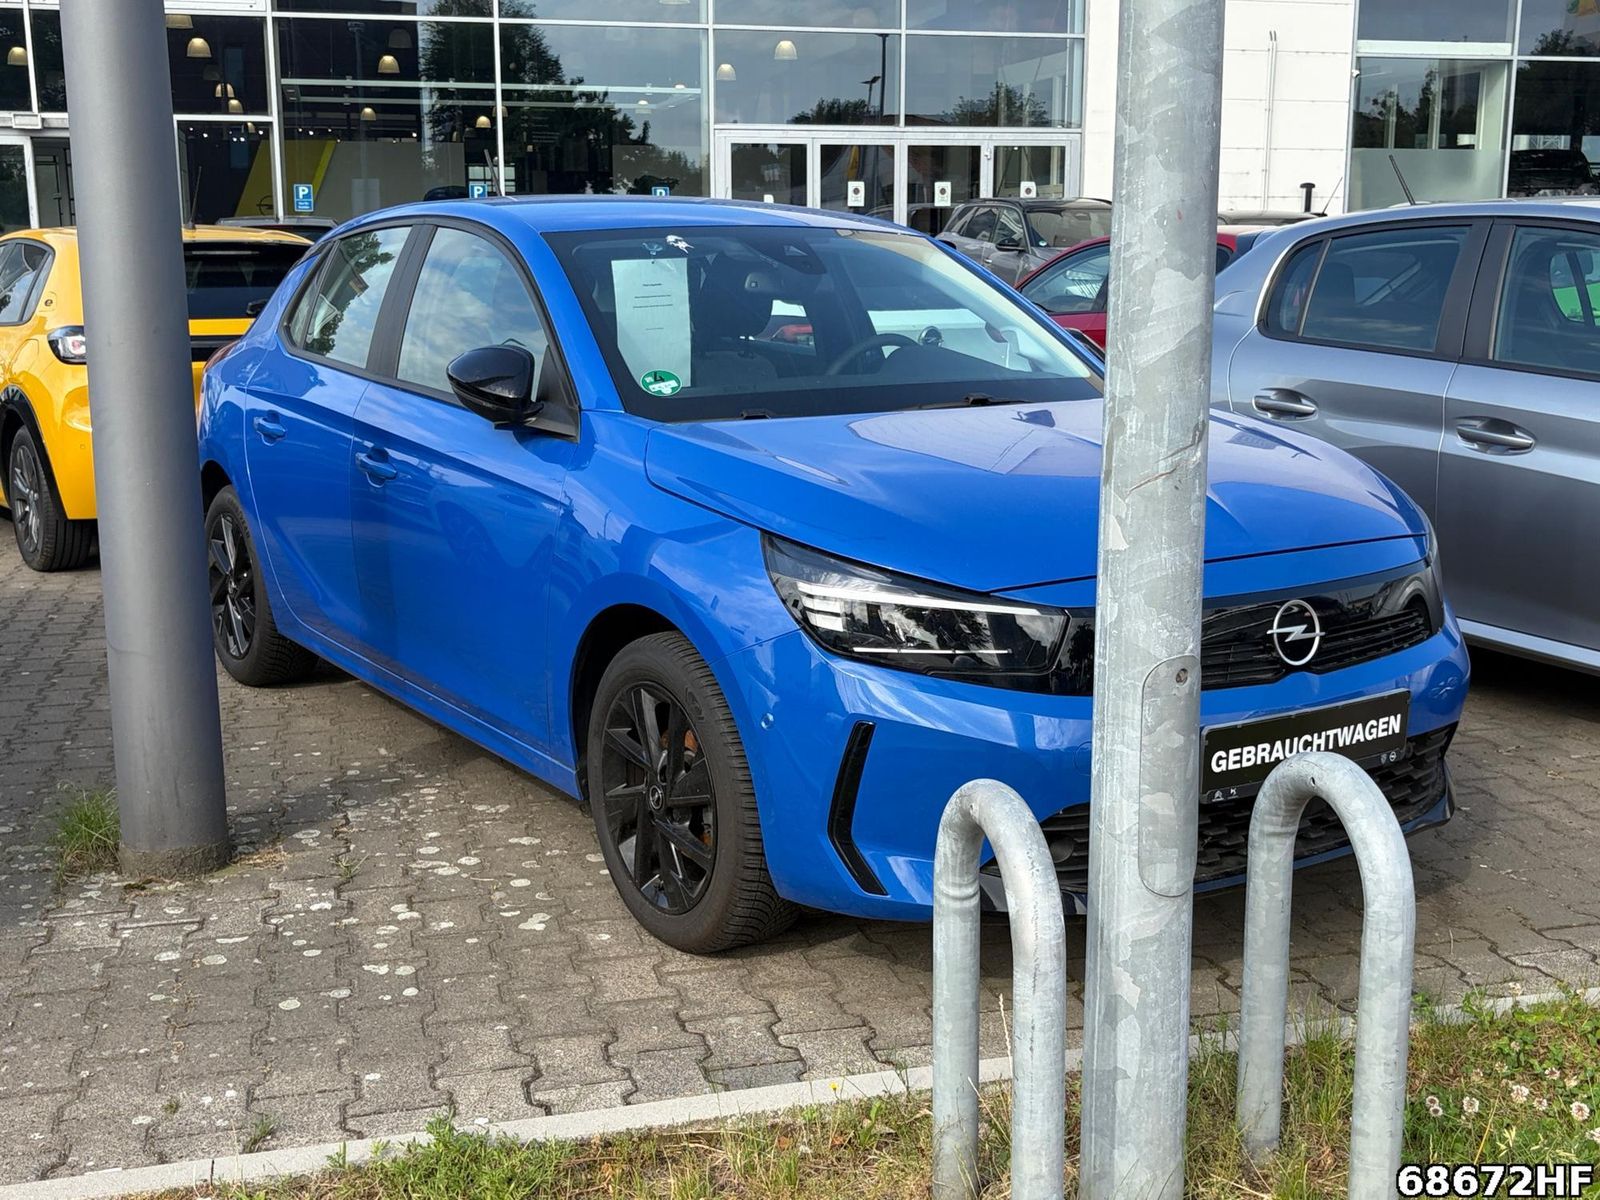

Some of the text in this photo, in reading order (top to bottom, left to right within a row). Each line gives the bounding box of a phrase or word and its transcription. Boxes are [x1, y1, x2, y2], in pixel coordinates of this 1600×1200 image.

[298, 186, 309, 199] P
[473, 186, 484, 199] P
[1211, 713, 1402, 773] GEBRAUCHTWAGEN
